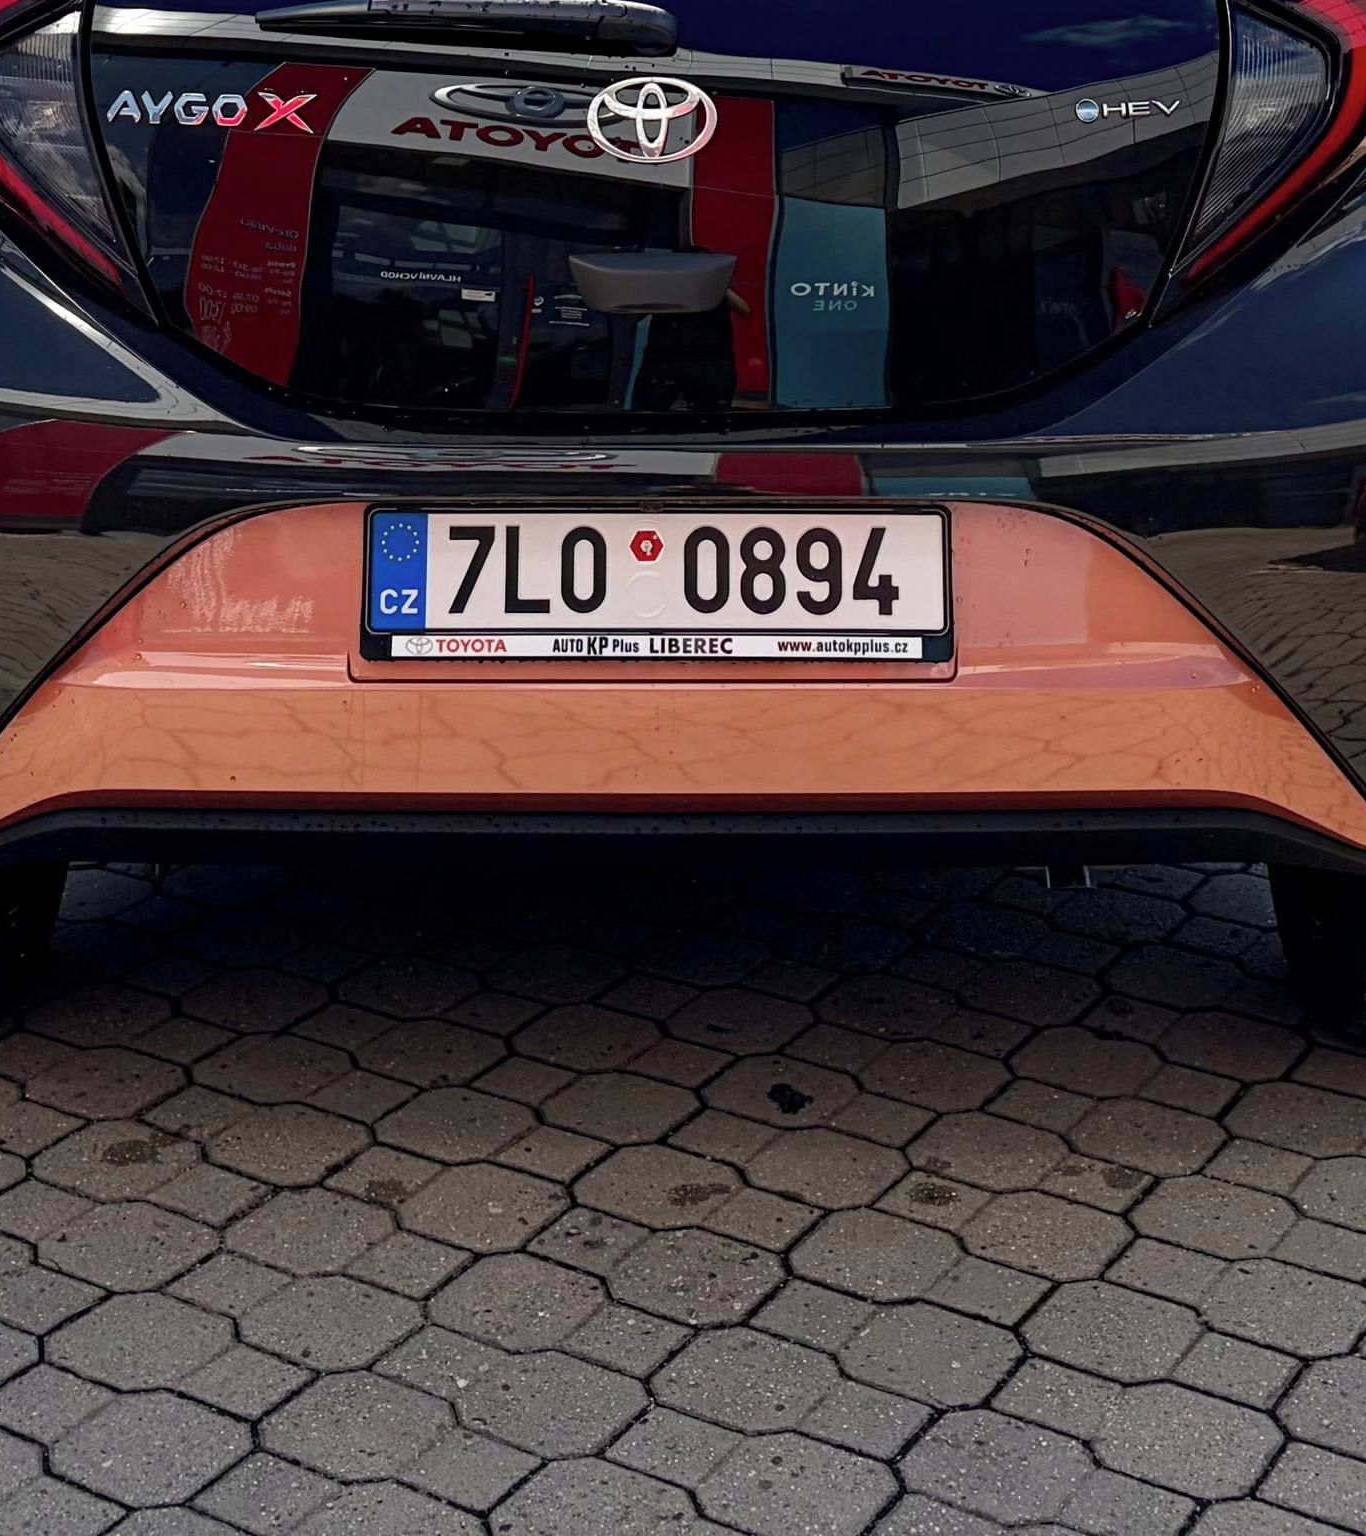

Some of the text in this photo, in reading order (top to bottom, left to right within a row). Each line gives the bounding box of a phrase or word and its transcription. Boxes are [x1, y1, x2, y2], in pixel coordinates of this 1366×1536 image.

[106, 90, 318, 134] AYGO X
[1102, 99, 1181, 116] HEV
[683, 526, 900, 616] 0894
[379, 589, 419, 615] CZ
[436, 635, 909, 656] TOYOTA AUTO KP Plus LIBEREC www.autokpplus.cz
